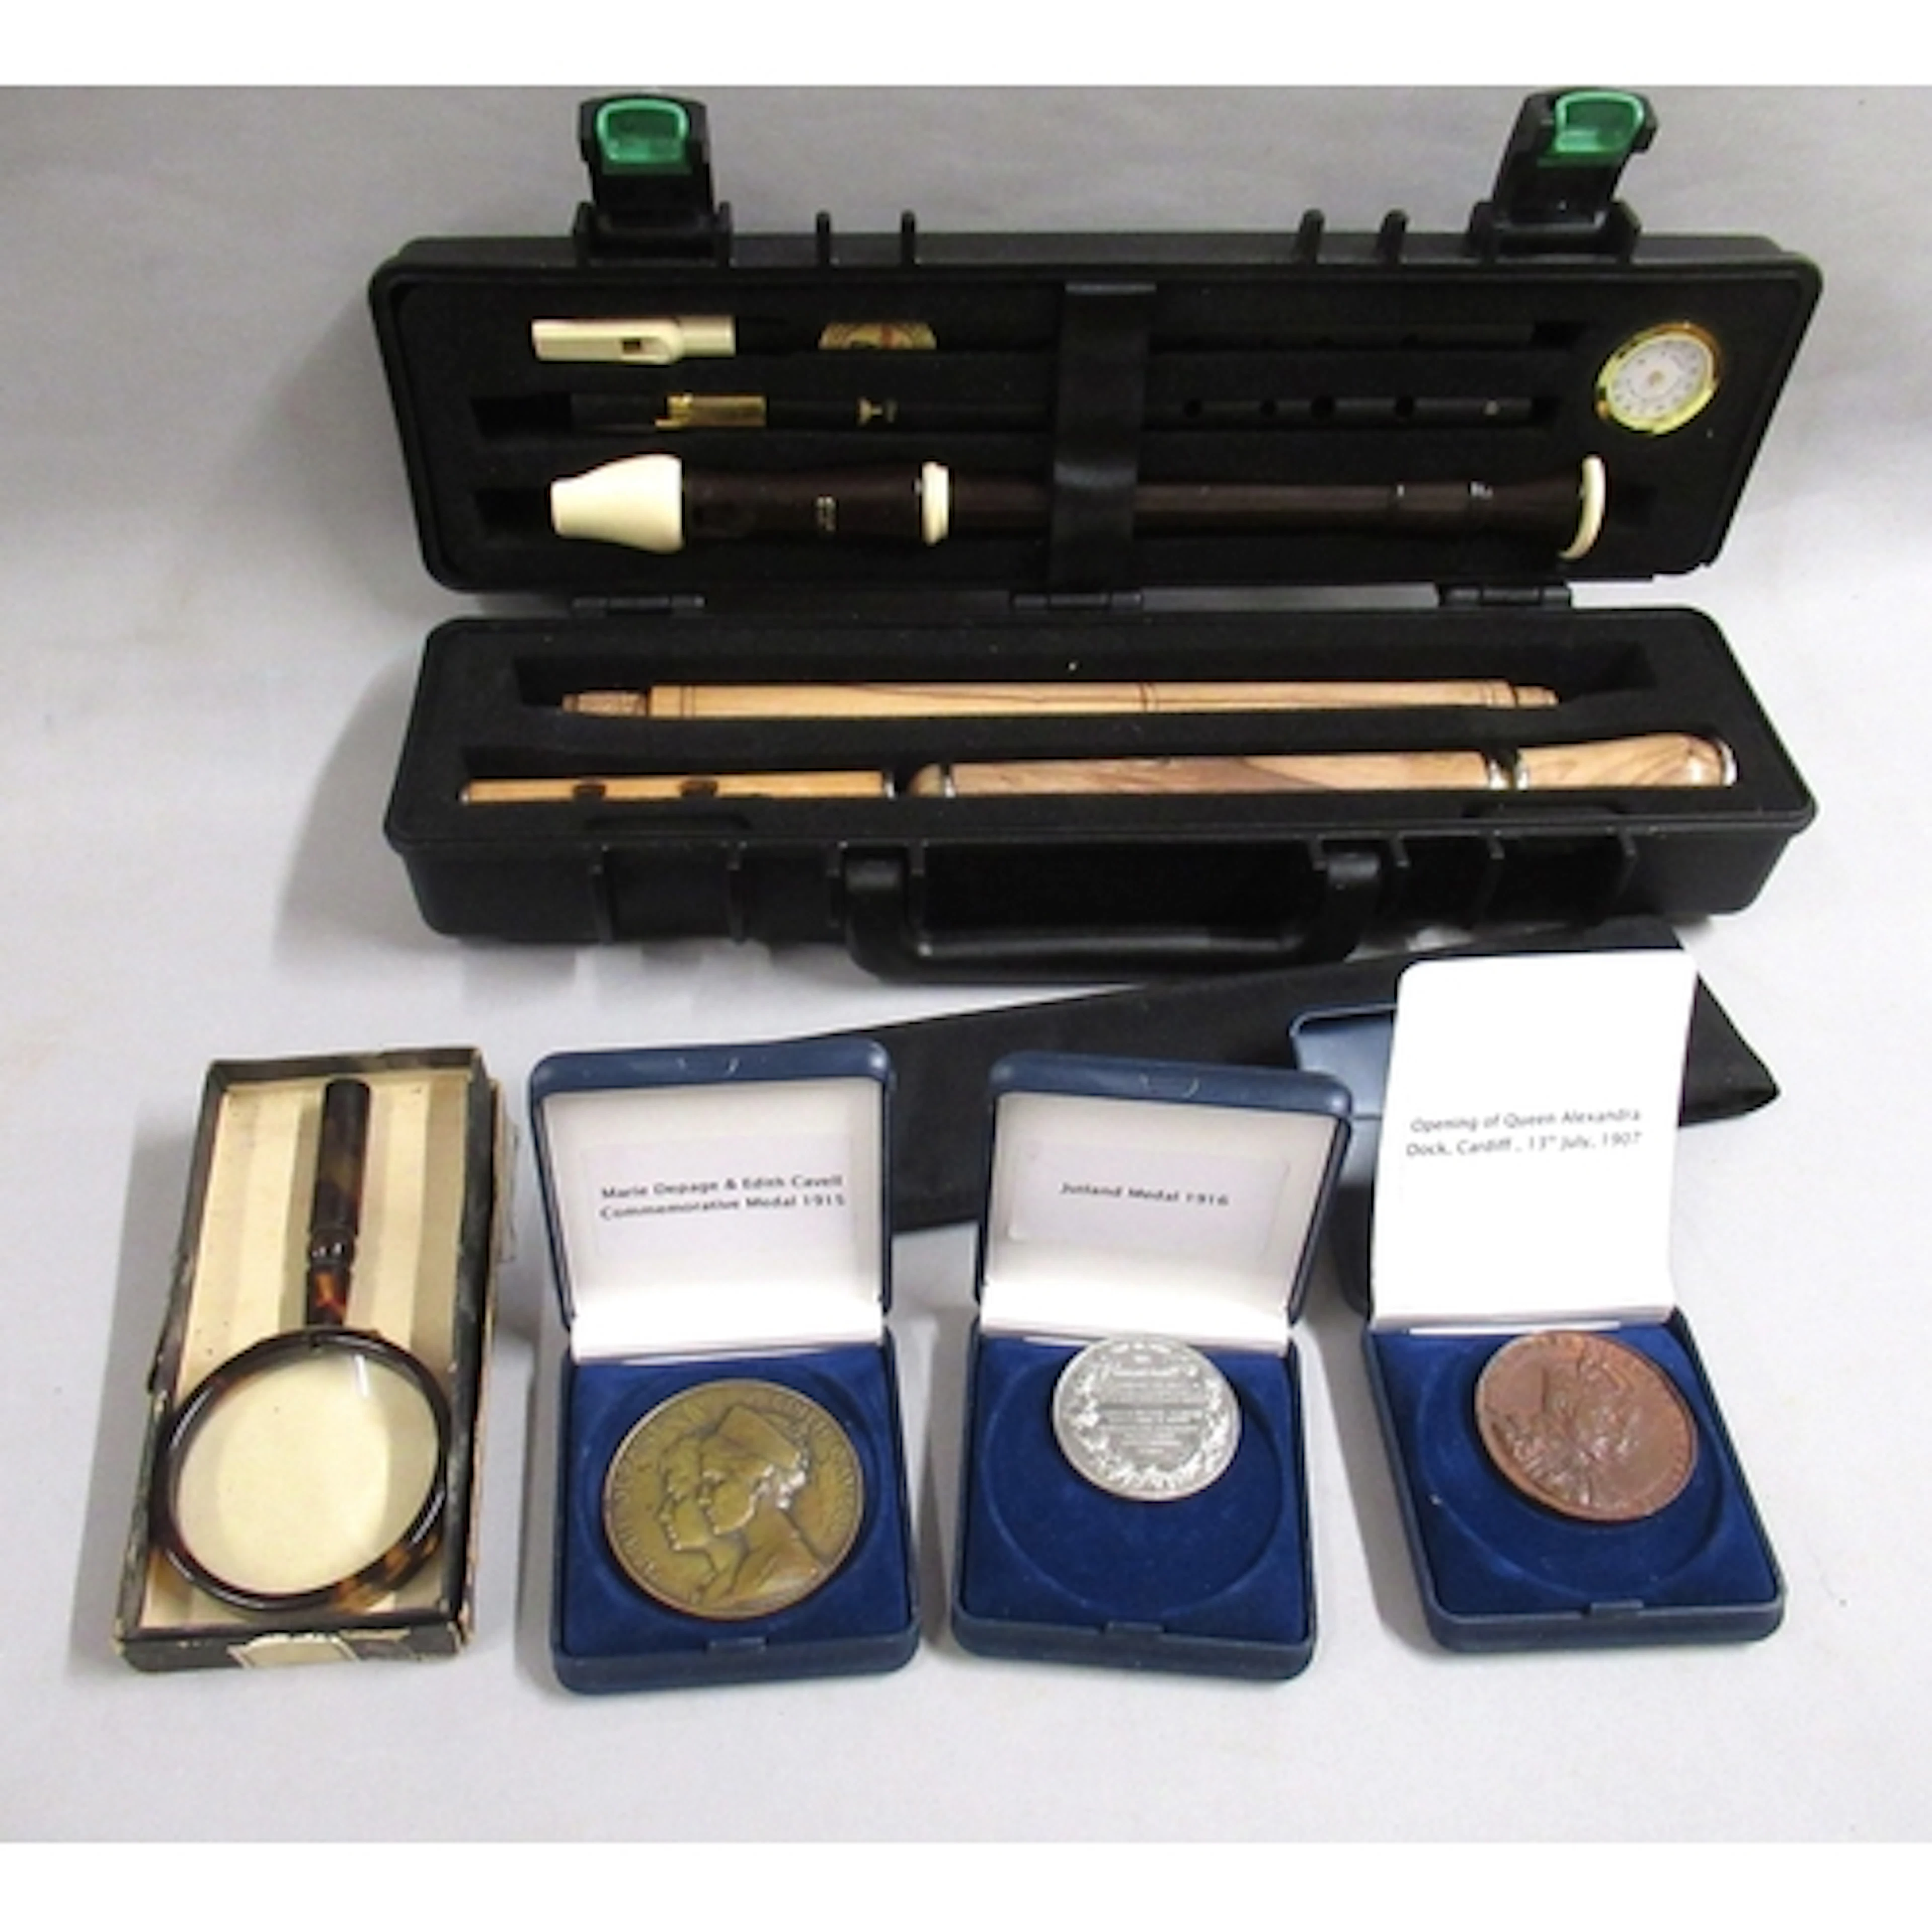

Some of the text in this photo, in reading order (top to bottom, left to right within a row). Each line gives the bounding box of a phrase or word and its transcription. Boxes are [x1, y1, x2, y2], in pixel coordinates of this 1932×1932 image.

[1411, 1108, 1640, 1133] Opening of Queen Alexandra
[602, 1185, 647, 1198] Marie
[725, 1177, 738, 1190] &
[791, 1174, 843, 1188] Cavell
[746, 1195, 796, 1208] Medal
